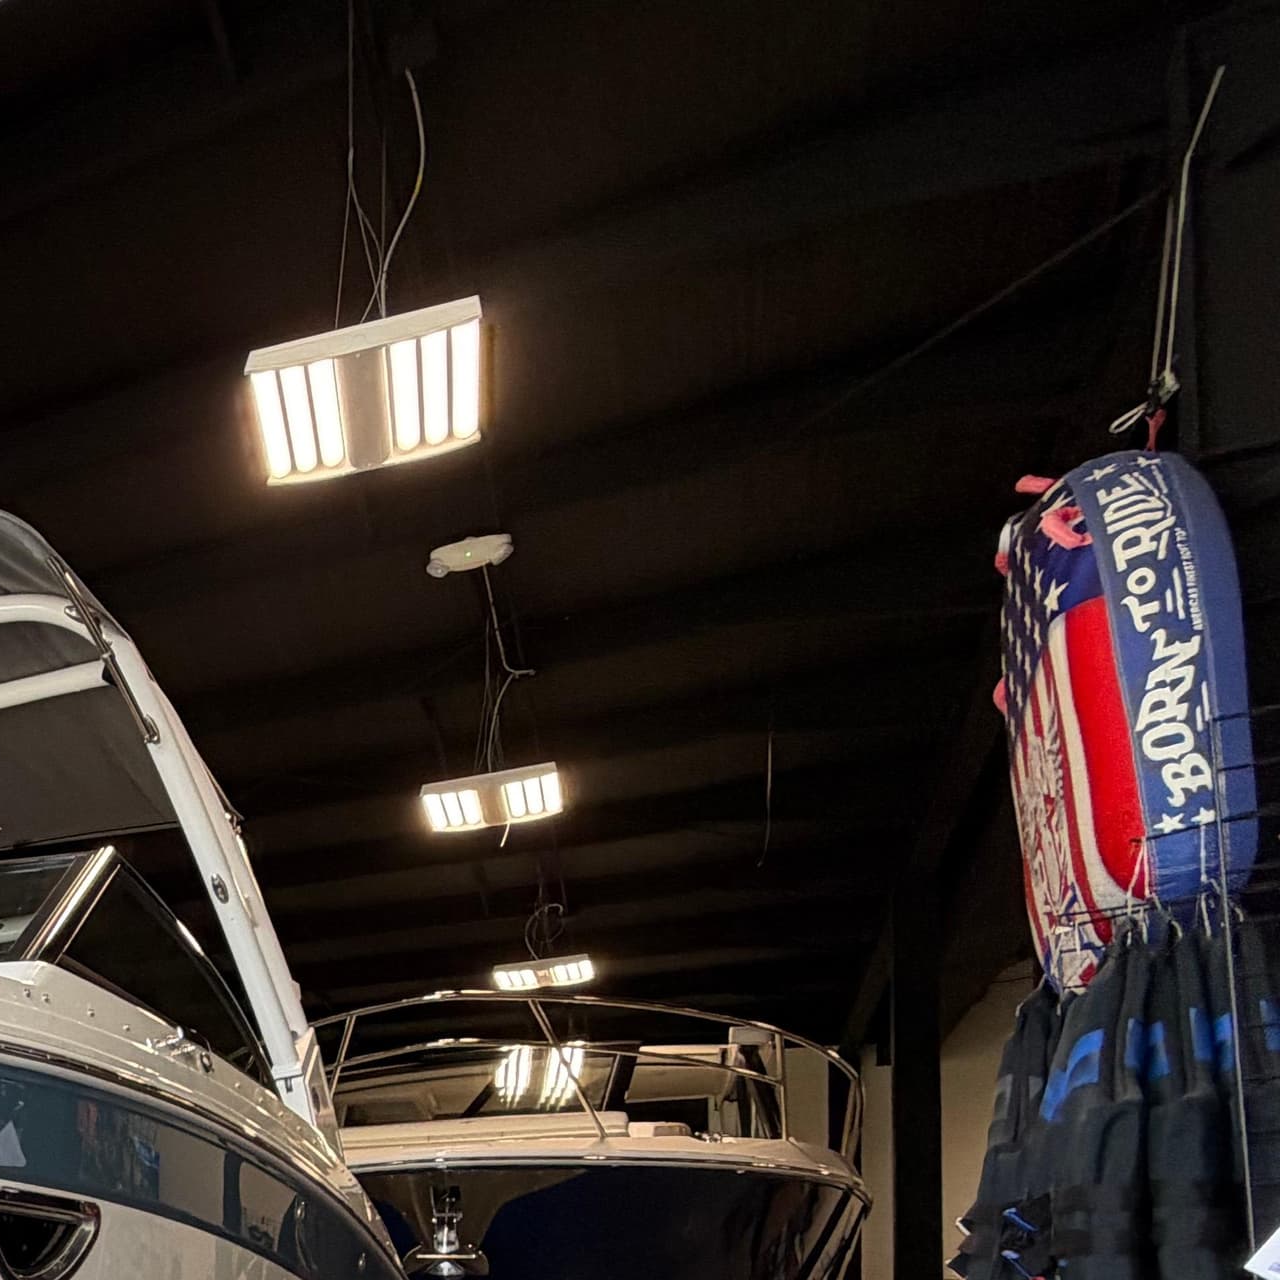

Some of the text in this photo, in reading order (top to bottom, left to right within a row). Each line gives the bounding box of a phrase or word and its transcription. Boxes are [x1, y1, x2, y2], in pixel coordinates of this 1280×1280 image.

[1096, 471, 1213, 808] BORN TO RIDE
